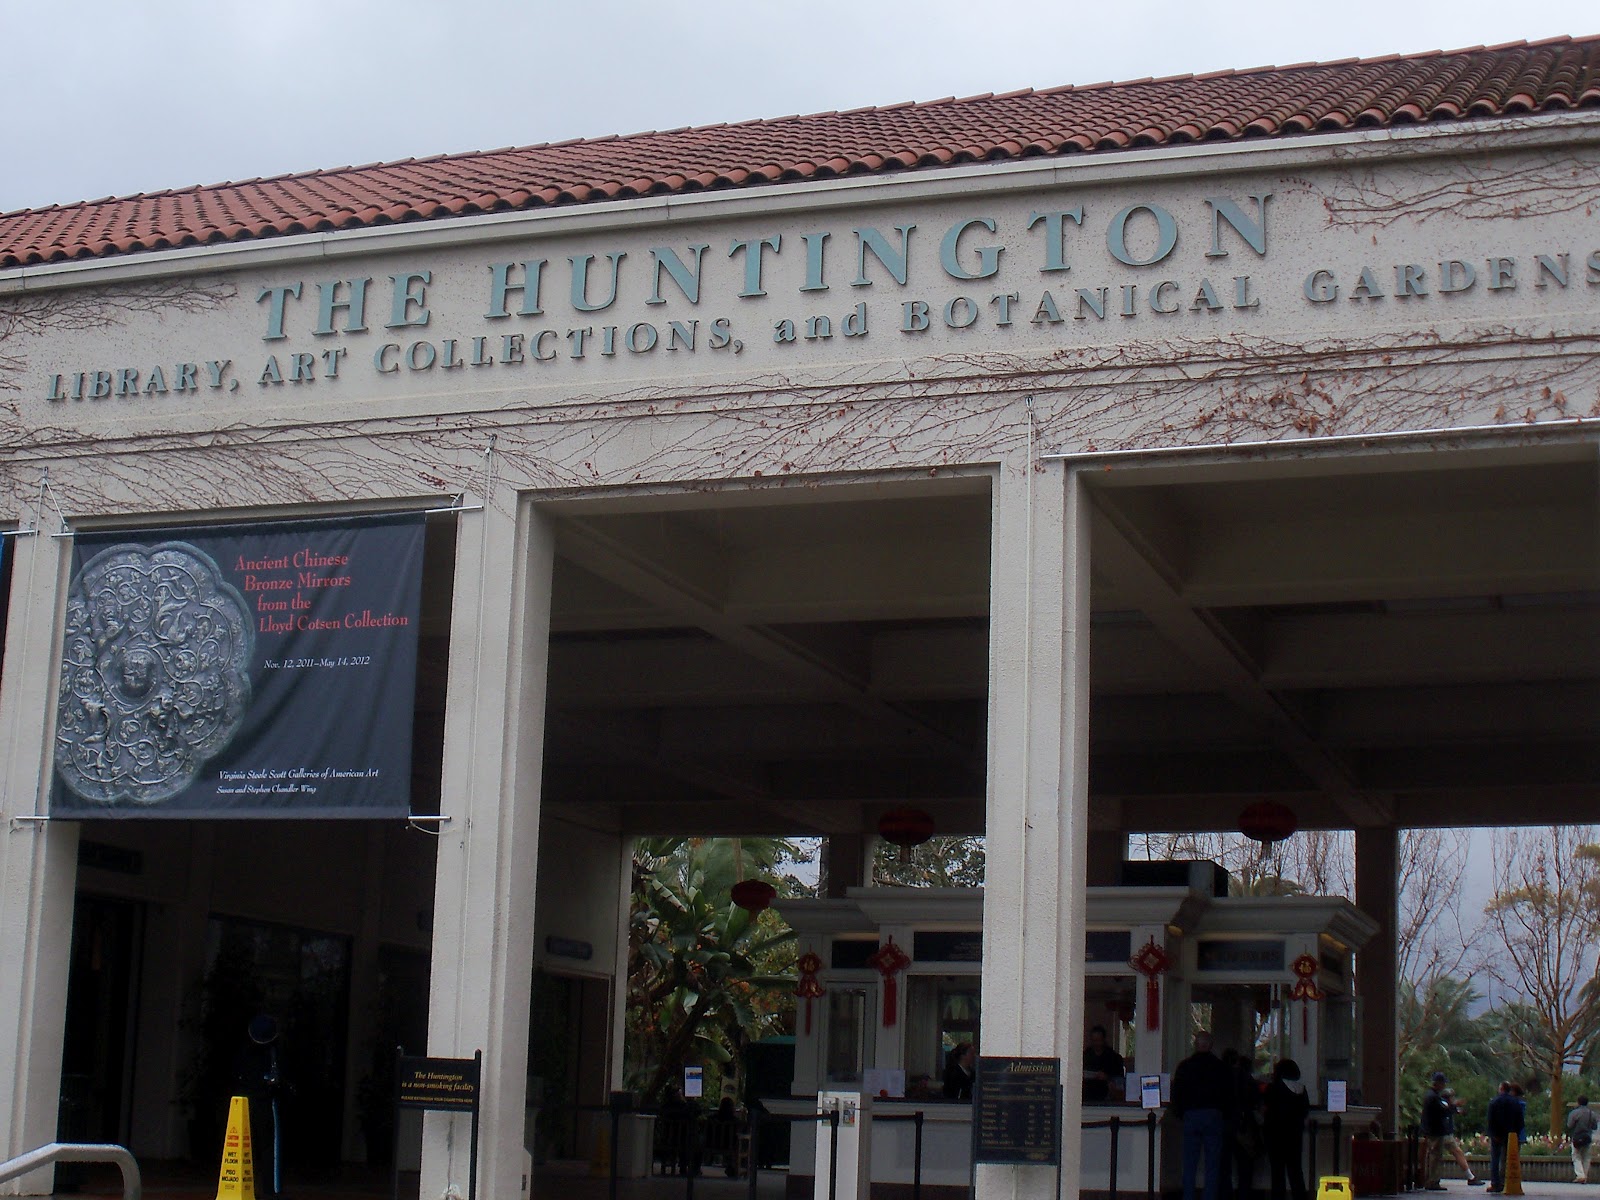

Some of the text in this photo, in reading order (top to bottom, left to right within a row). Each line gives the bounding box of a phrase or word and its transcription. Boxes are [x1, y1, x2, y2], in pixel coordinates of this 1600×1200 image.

[256, 193, 1274, 341] THE HUNTINGTON
[46, 249, 1600, 401] LIBRARY, ART COLLECTIONS, and BOTANICAL GARDENS
[234, 548, 348, 571] Ancient Chinese
[244, 572, 351, 591] Bronze Mirrors
[257, 592, 311, 611] from the
[259, 610, 408, 635] Lloyd Cotsen Collection
[263, 659, 280, 669] Nov.
[350, 656, 370, 666] 2012
[218, 767, 379, 782] Virginia Steele Scott Galleries of American Art
[234, 785, 247, 794] and
[271, 784, 299, 793] Chandler
[300, 785, 317, 794] Wing
[414, 1071, 463, 1081] The Huntington
[1004, 1062, 1054, 1073] Admission
[413, 1082, 453, 1091] non-smoking
[453, 1082, 474, 1092] facility
